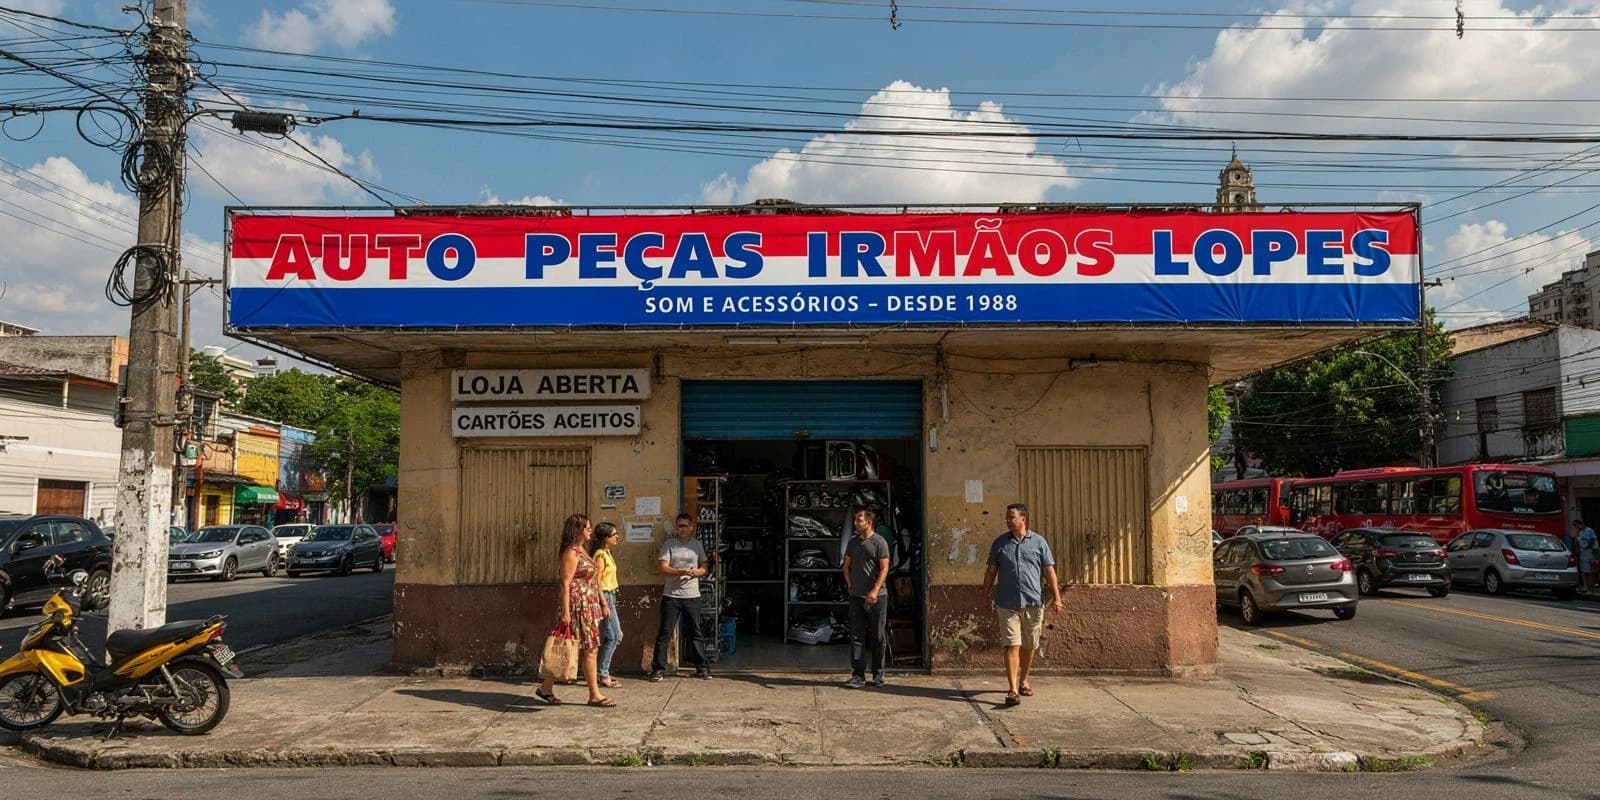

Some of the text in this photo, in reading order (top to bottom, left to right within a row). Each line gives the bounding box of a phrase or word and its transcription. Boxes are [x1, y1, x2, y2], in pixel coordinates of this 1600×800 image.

[265, 218, 1391, 291] AUTO PEÇAS IRMÃOS LOPES
[645, 296, 694, 313] SOM
[703, 296, 713, 313] E
[721, 292, 860, 313] ACESSÓRIOS
[887, 295, 957, 312] DESDE
[966, 294, 1018, 311] 1988
[458, 375, 639, 395] LOJA ABERTA
[457, 410, 636, 430] CARTÕES ACEITOS
